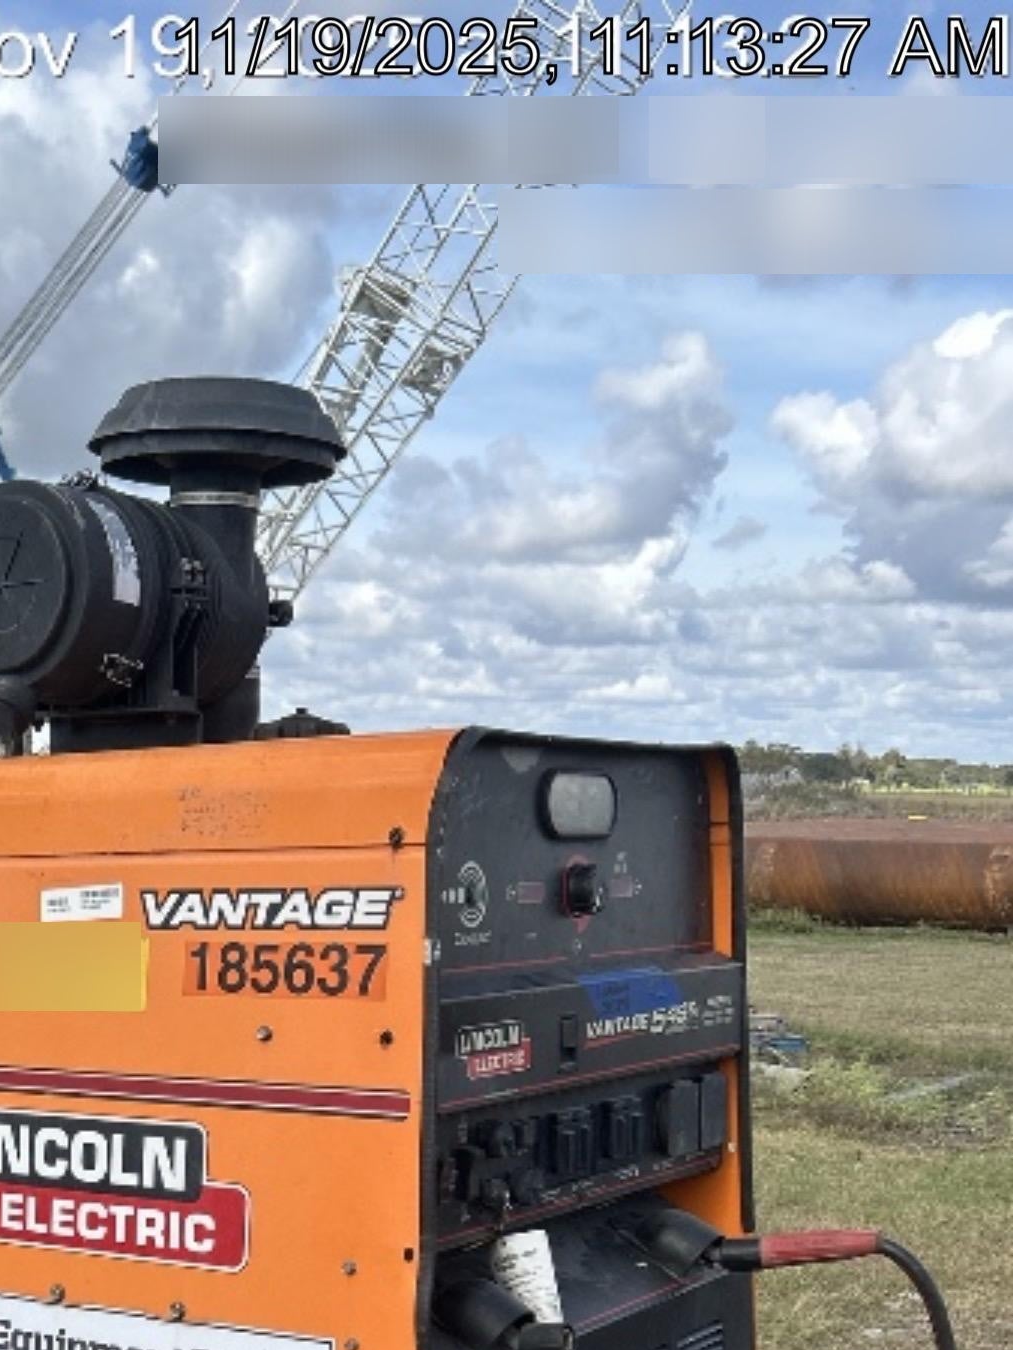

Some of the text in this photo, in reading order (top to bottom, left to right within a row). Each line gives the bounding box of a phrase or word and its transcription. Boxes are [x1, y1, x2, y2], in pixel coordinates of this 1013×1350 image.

[140, 887, 400, 931] VANTAGE
[189, 940, 387, 997] 185637
[0, 1192, 217, 1254] ELECTRIC
